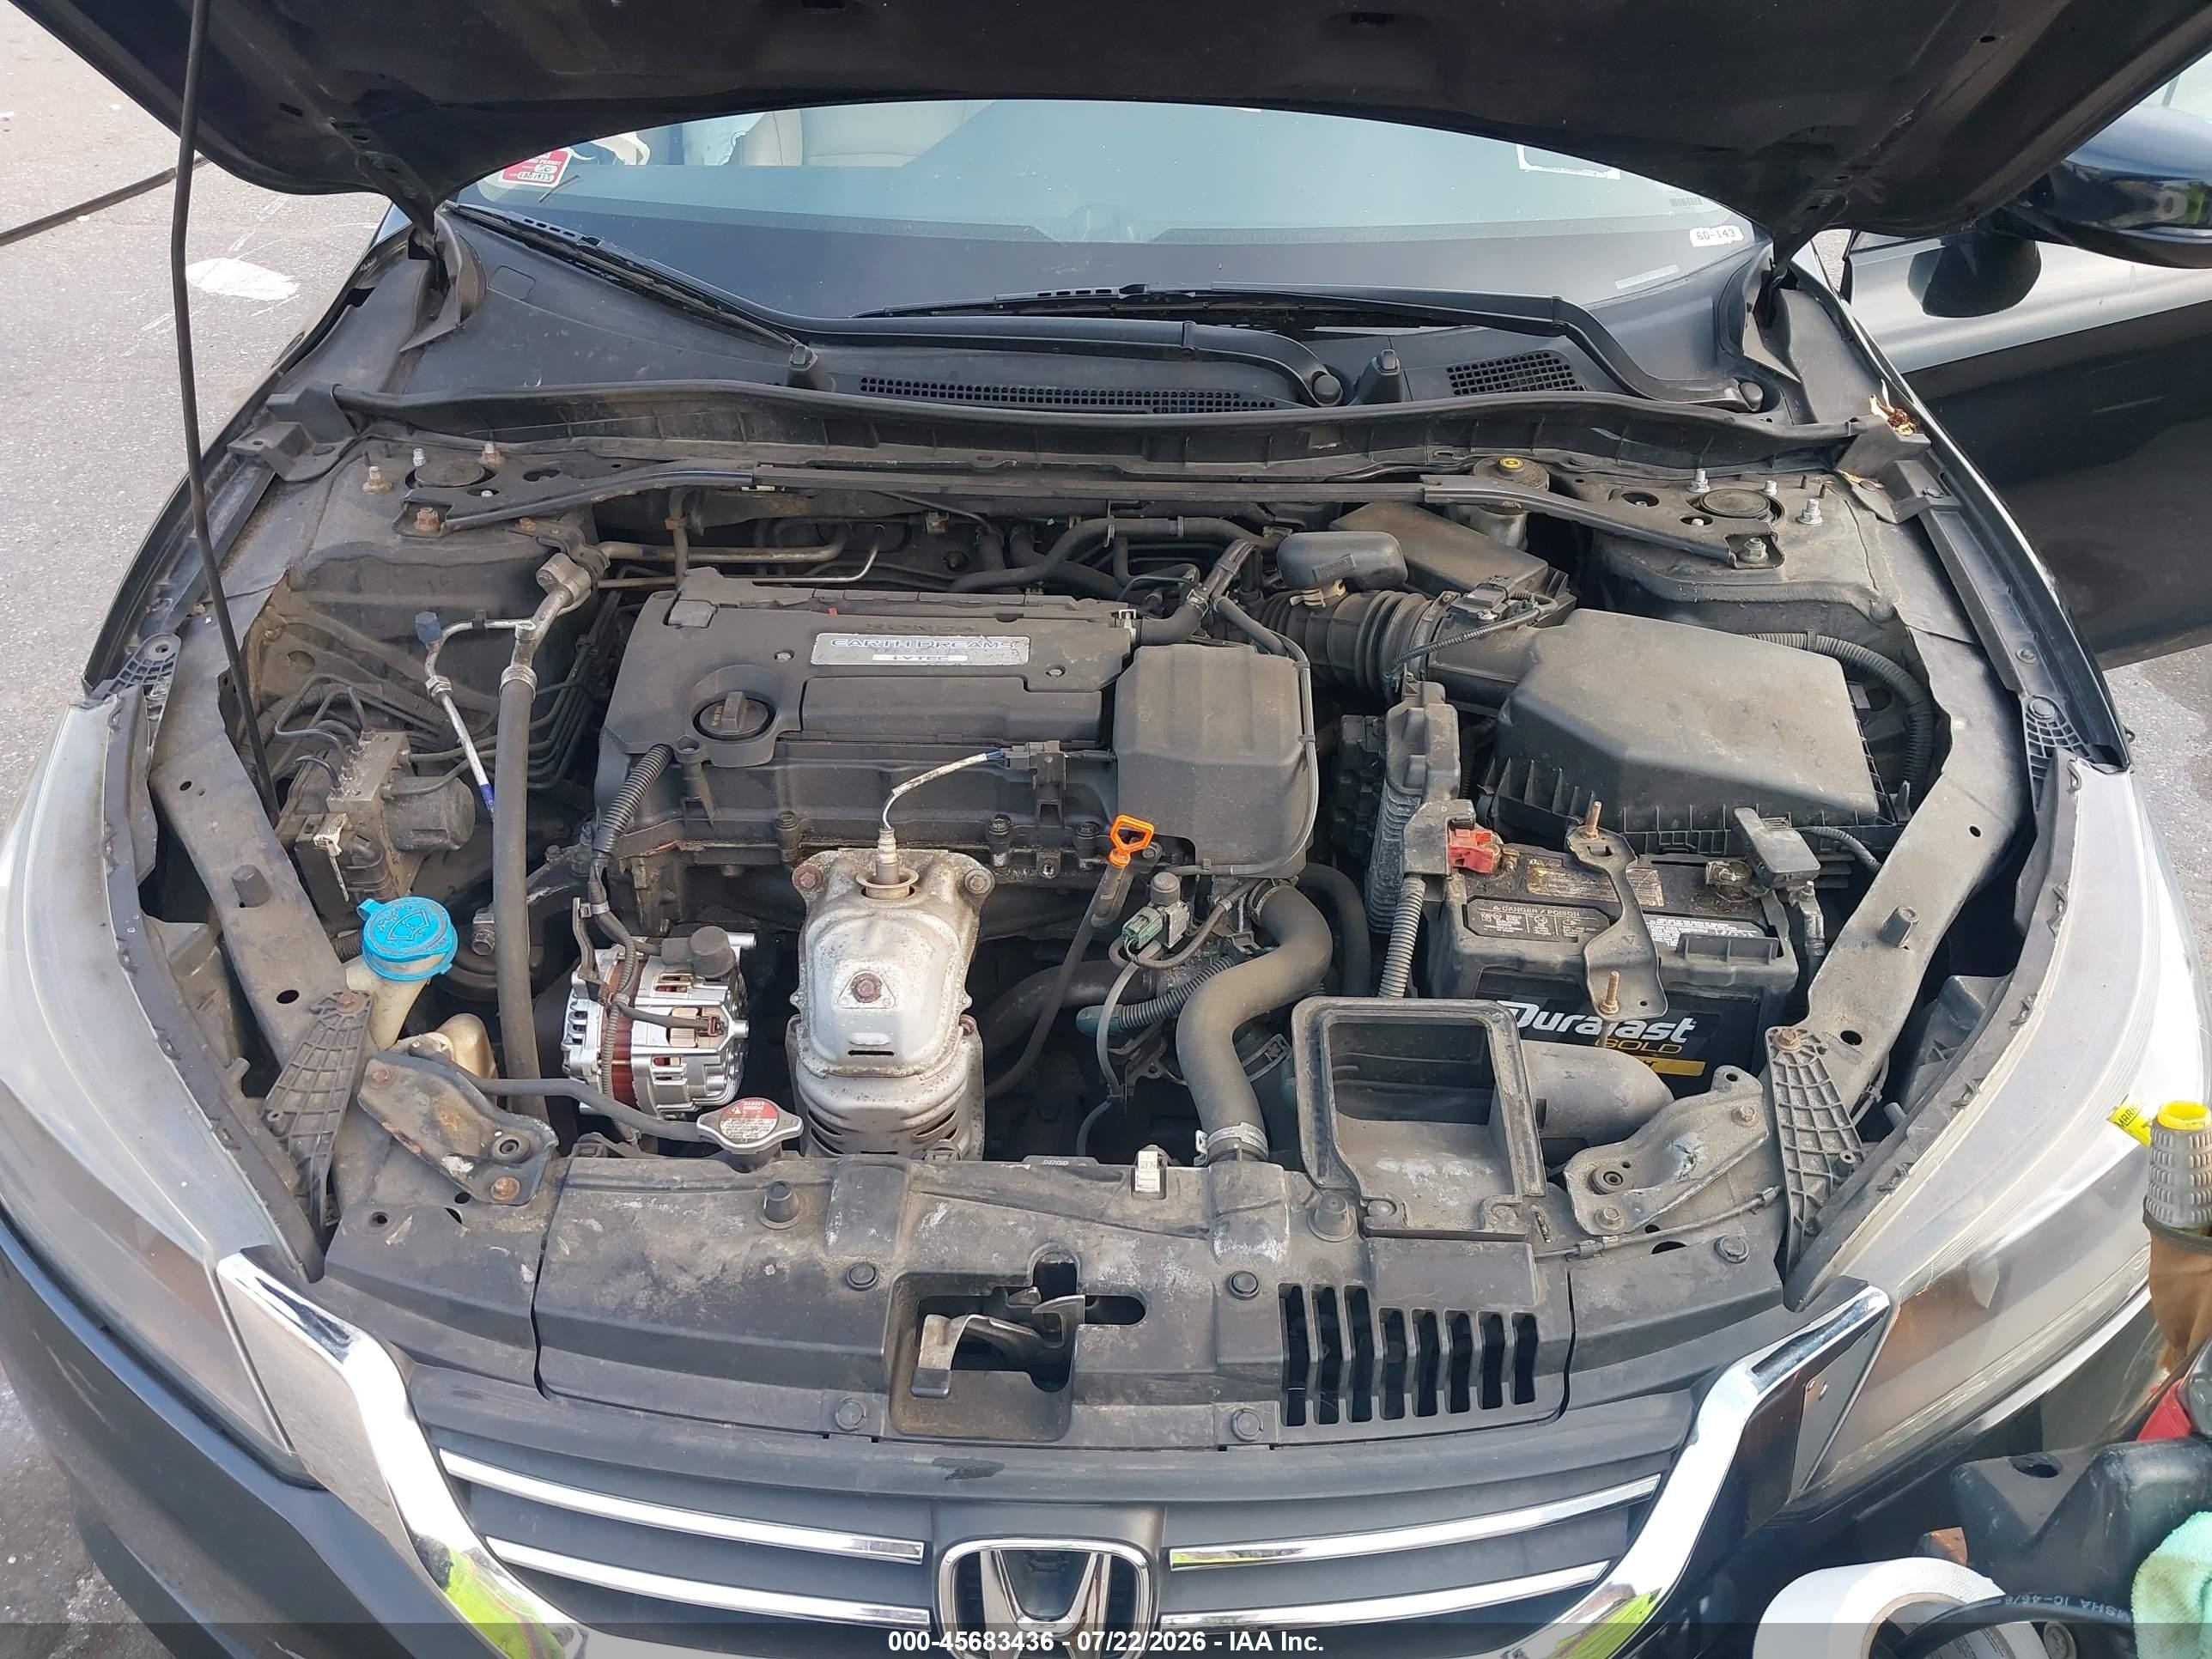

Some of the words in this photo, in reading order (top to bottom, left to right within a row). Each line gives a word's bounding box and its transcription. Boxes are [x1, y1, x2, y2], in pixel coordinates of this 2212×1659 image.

[830, 638, 911, 649] EARTH
[1502, 905, 1538, 915] DANGER
[1547, 908, 1580, 917] POISON
[1595, 1038, 1683, 1054] GOLD
